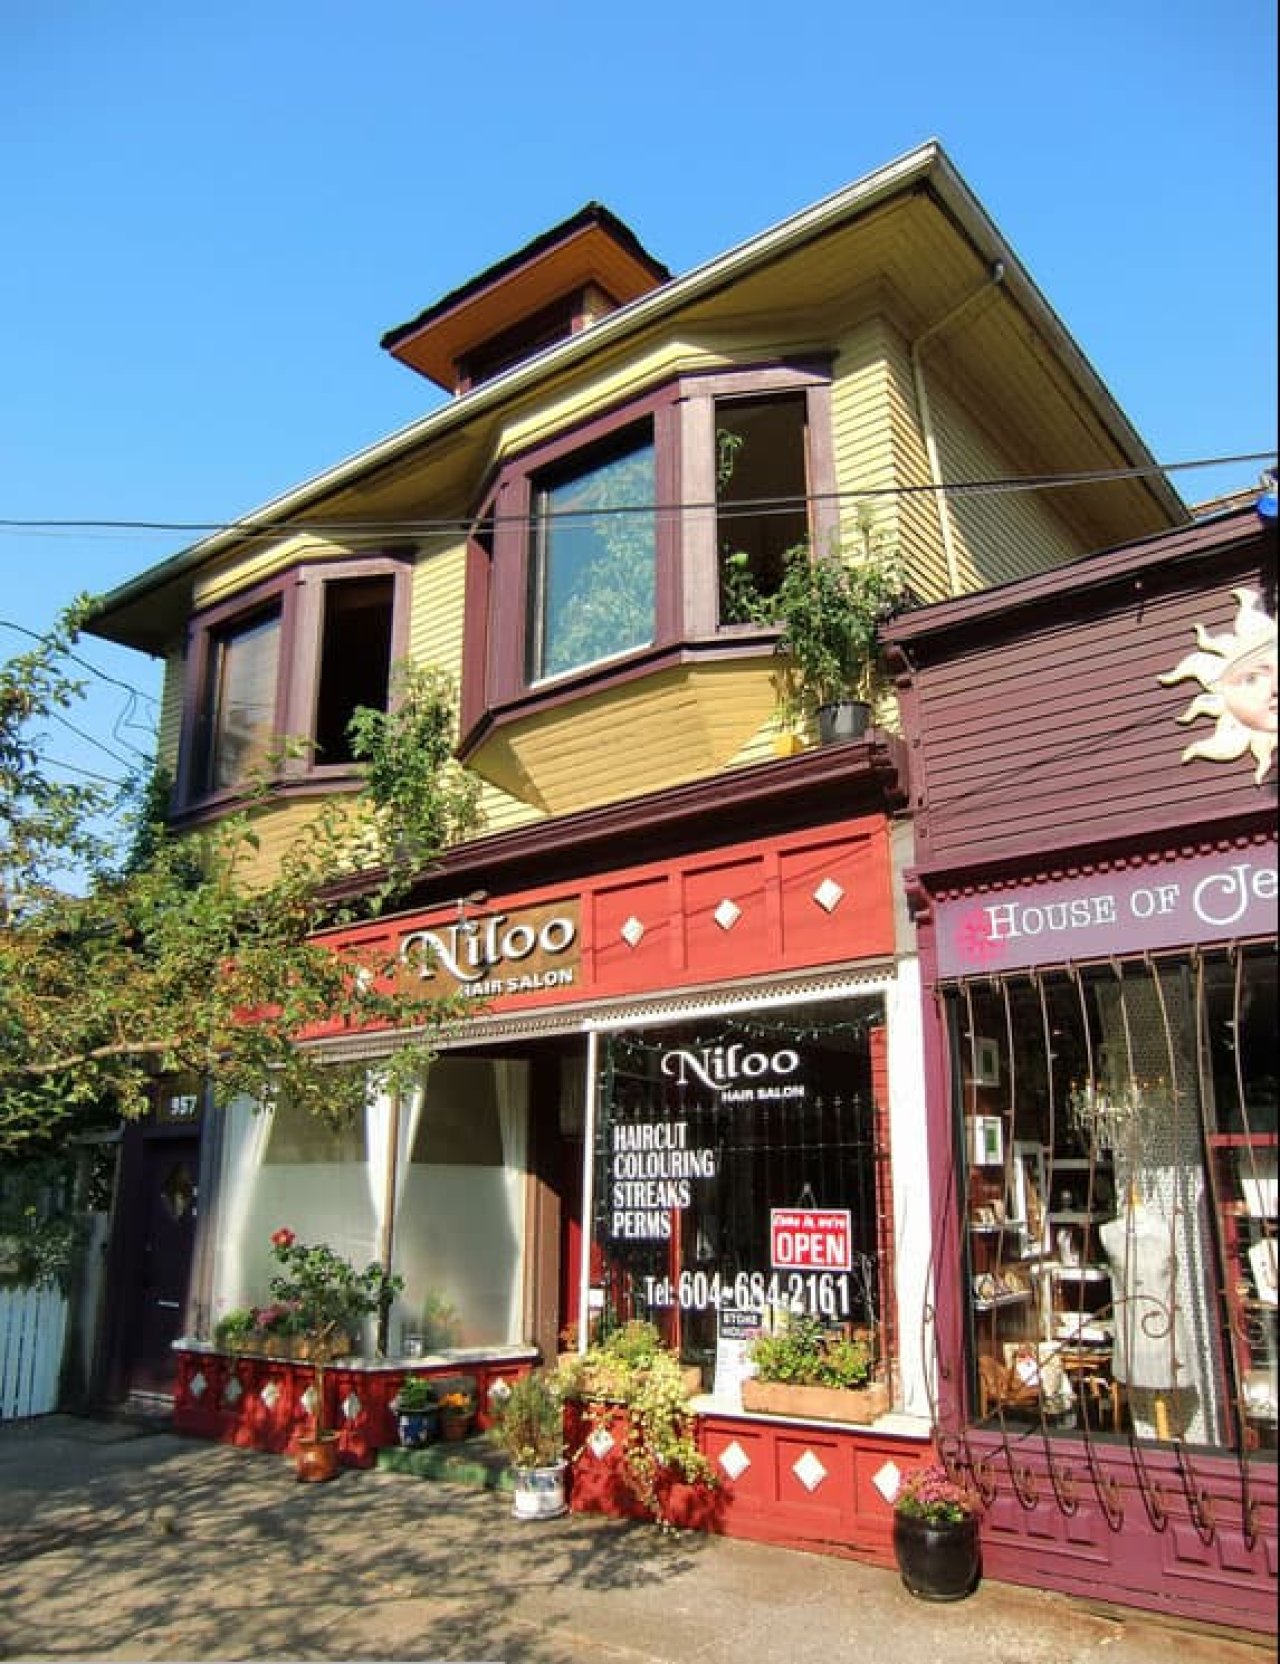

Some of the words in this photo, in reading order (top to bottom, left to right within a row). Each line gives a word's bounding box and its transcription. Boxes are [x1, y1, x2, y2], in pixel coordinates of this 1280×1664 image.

[984, 895, 1116, 940] HOUSE
[1131, 885, 1180, 918] OF
[400, 914, 575, 982] Niloo
[505, 969, 573, 991] SALON
[661, 1043, 800, 1090] Niloo
[613, 1122, 688, 1151] HAIRCUT
[613, 1149, 716, 1180] COLOURING
[612, 1181, 691, 1209] STREAKS
[612, 1210, 671, 1239] PERMS
[776, 1232, 845, 1264] OPEN
[646, 1277, 675, 1306] Tel:
[680, 1271, 850, 1316] 604-684-2161
